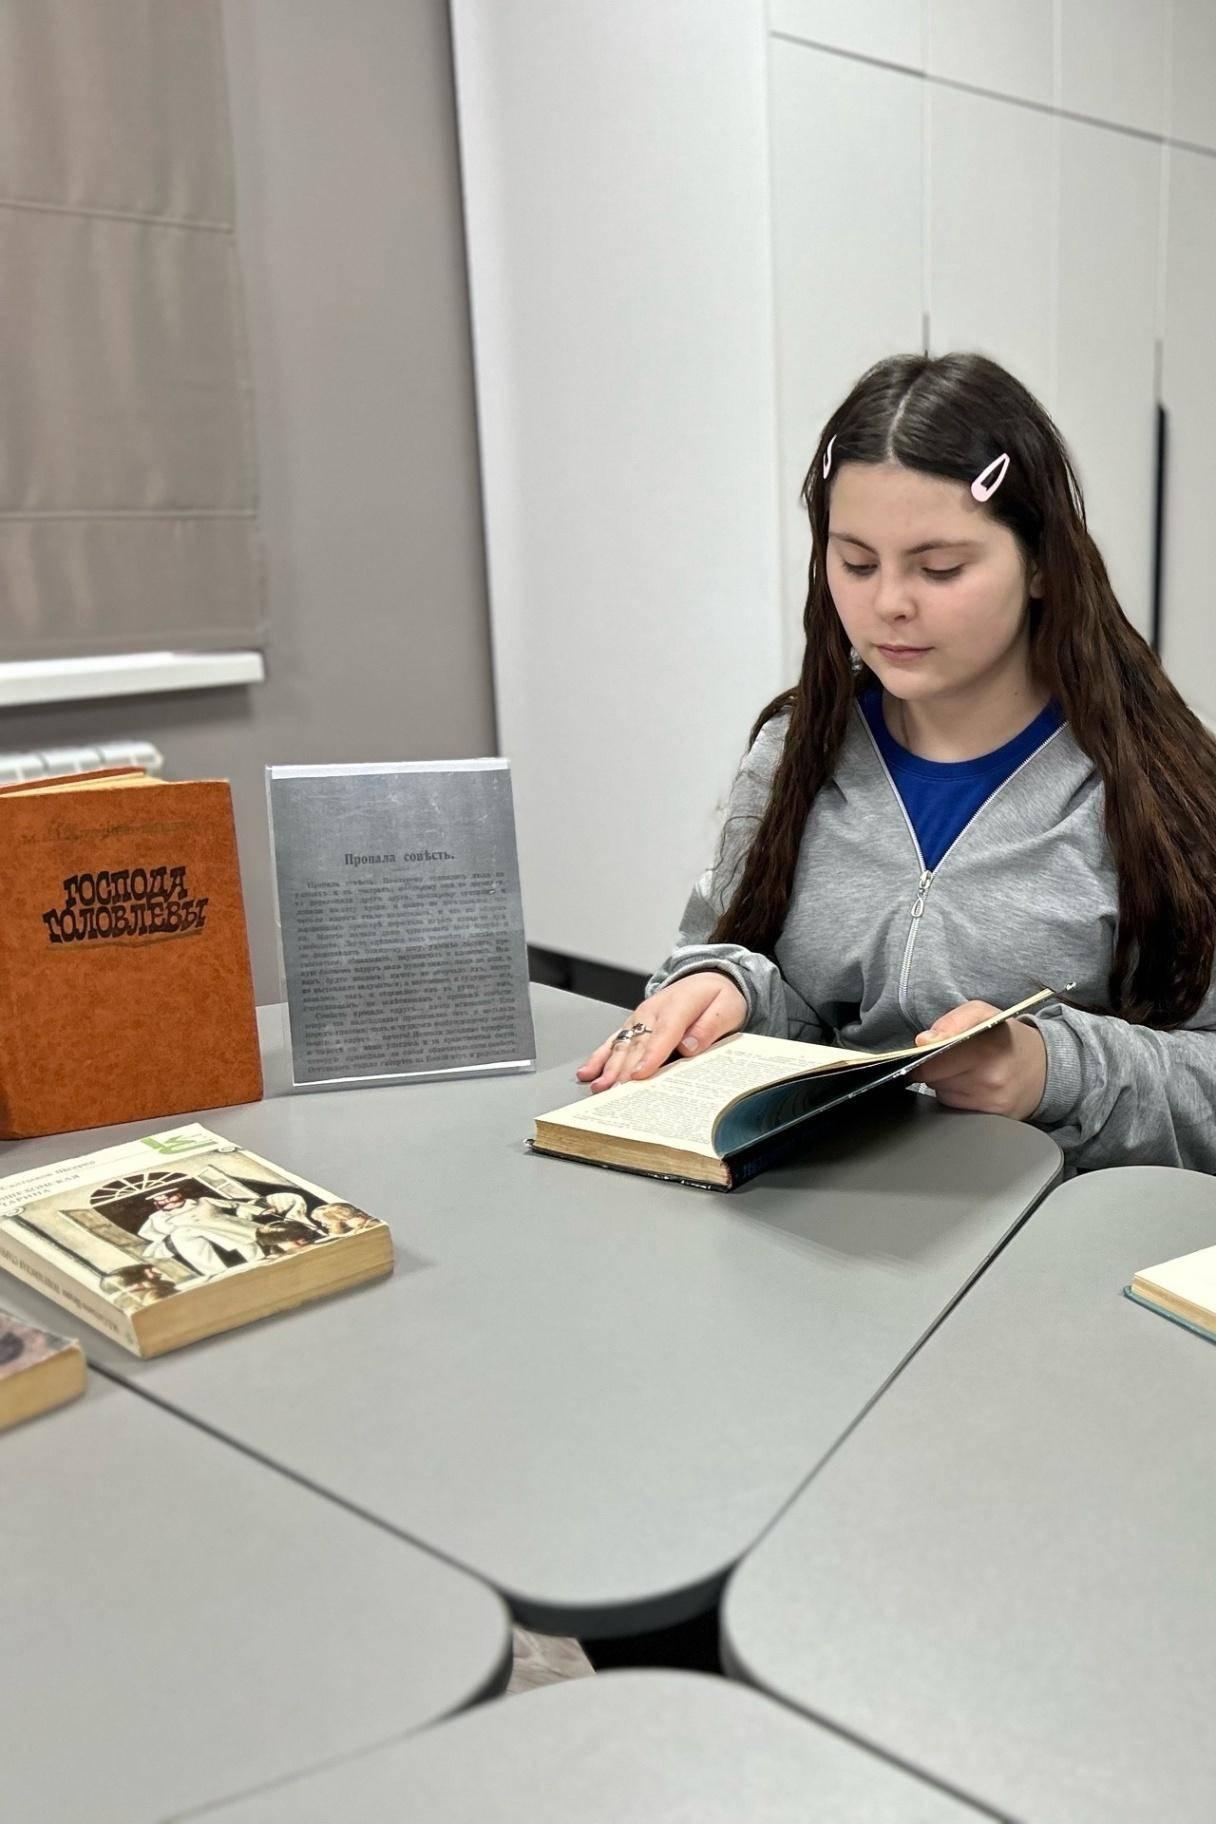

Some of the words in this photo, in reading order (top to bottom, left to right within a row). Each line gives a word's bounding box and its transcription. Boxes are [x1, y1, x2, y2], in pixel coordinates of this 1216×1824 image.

[344, 853, 396, 868] Пропала
[63, 866, 188, 908] ГОСПОДА
[43, 898, 209, 943] ГОЛОВЛЕВЫ
